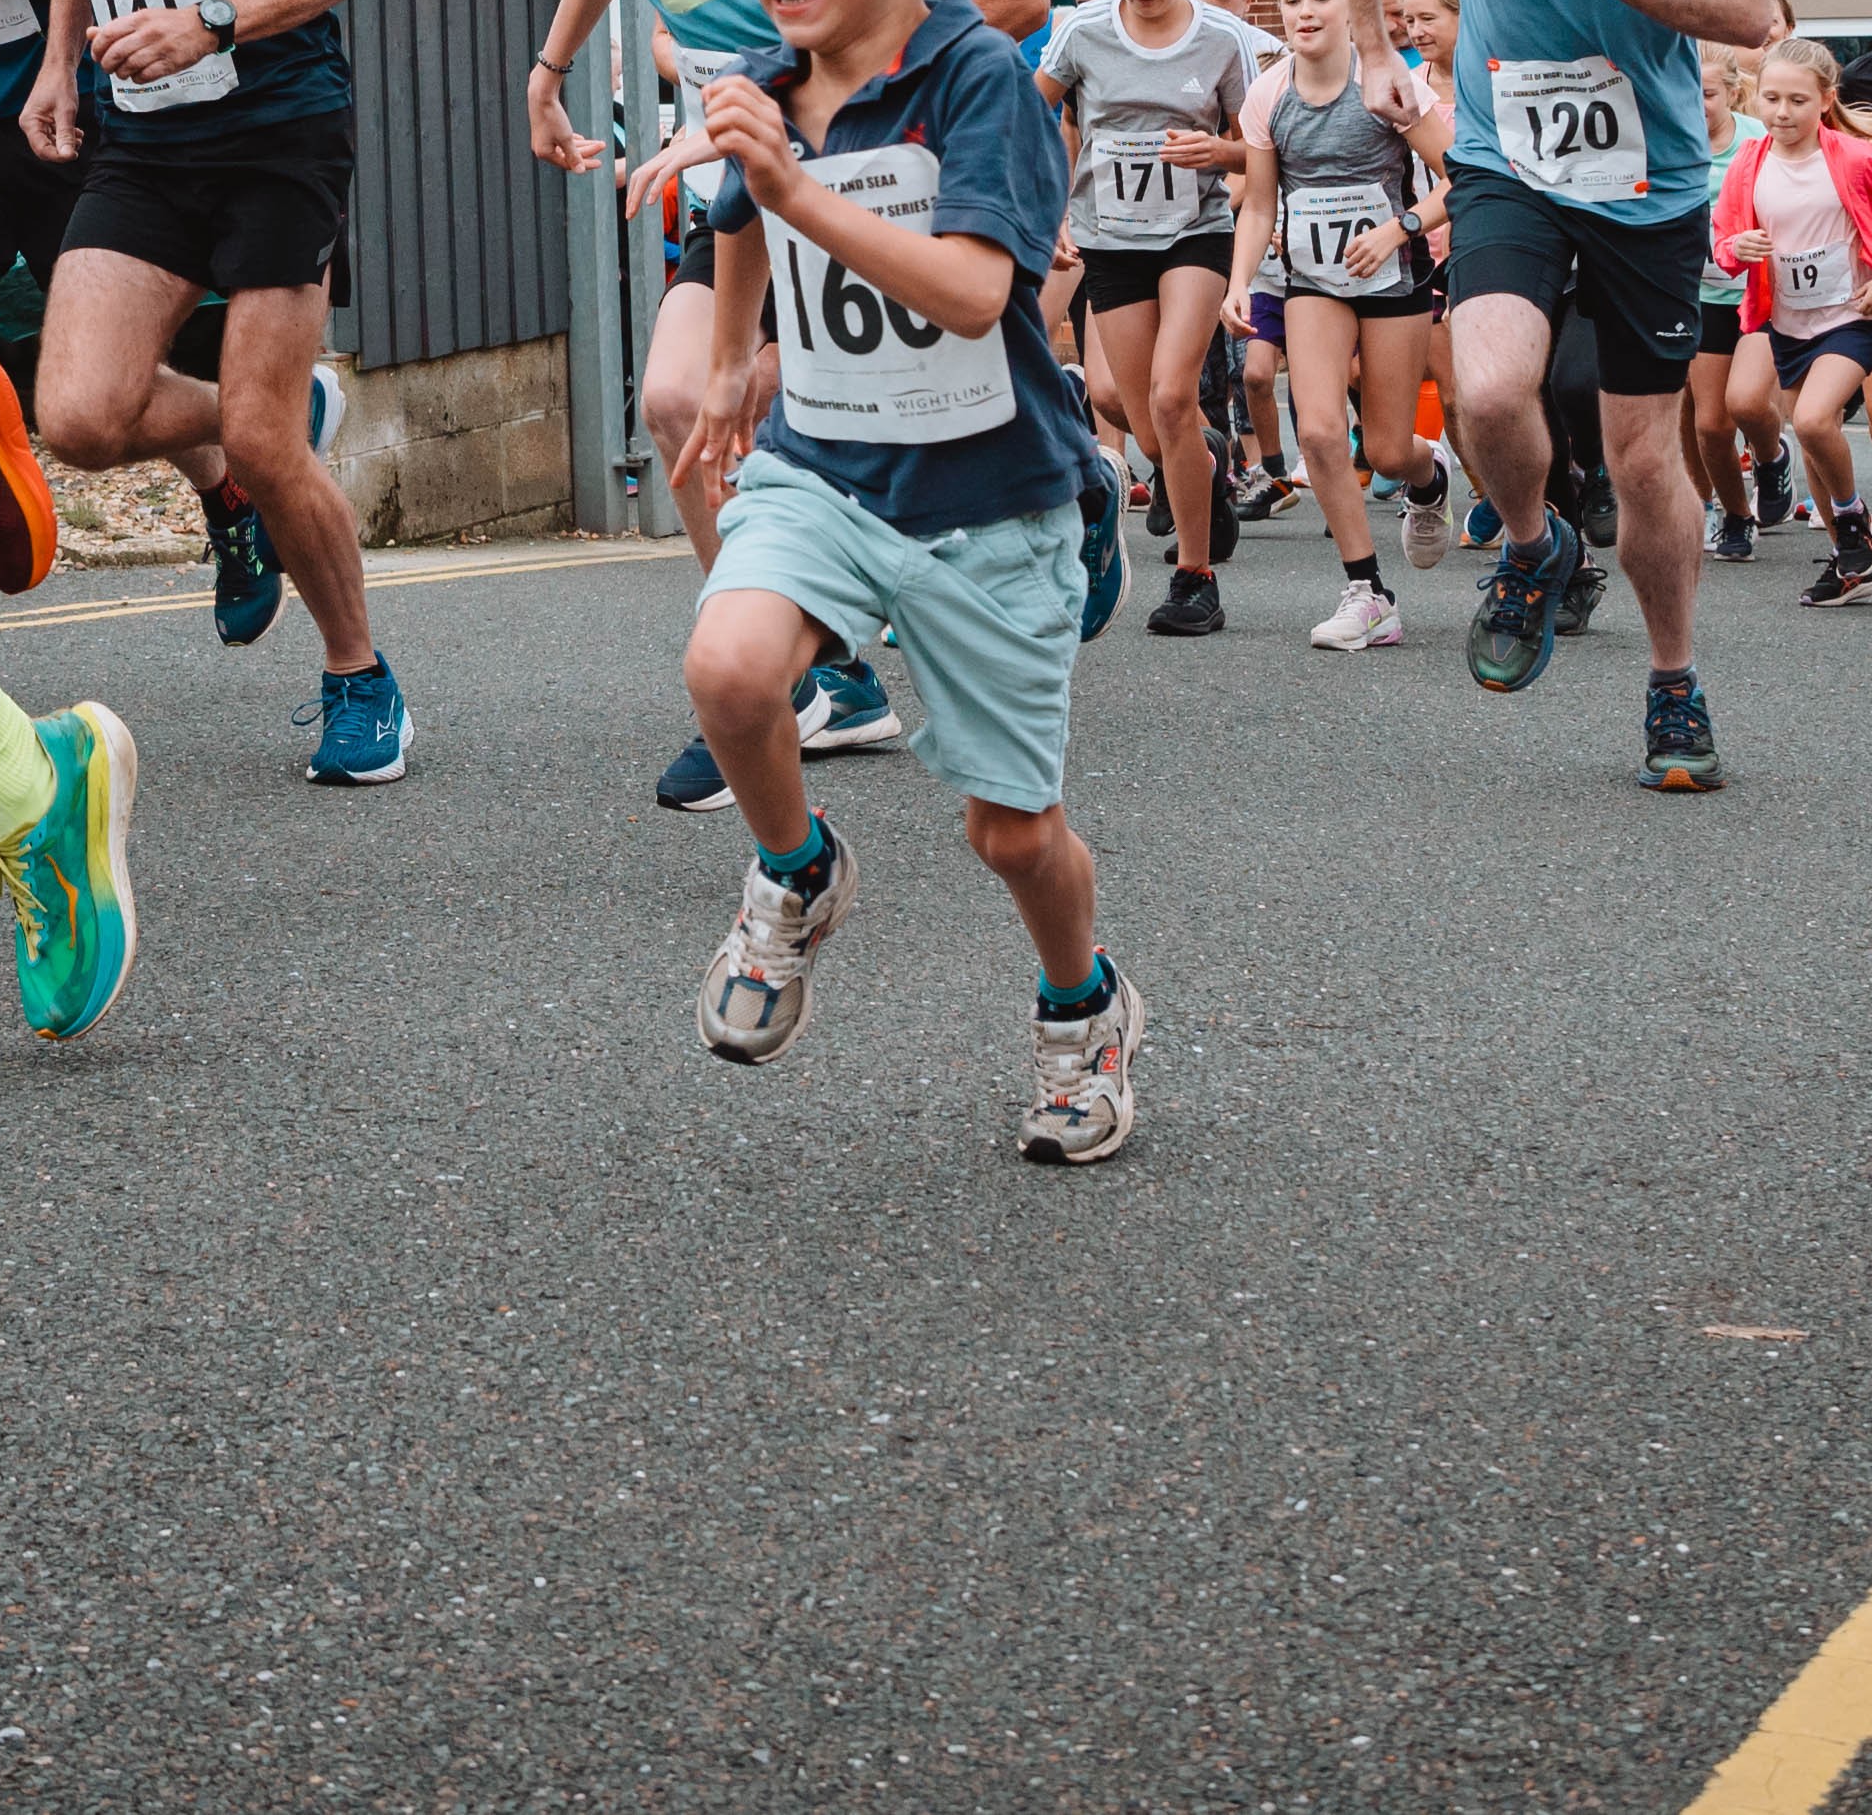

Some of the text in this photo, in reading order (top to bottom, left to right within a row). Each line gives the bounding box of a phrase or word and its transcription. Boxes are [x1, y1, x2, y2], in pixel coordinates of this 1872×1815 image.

[1526, 100, 1619, 161] 120
[840, 178, 864, 194] AND
[867, 174, 898, 189] SEAA
[1114, 161, 1175, 202] 171
[887, 201, 929, 218] SERIES
[1780, 253, 1805, 264] RYDE
[1791, 264, 1818, 290] 19
[892, 383, 993, 410] WIGHTLINK
